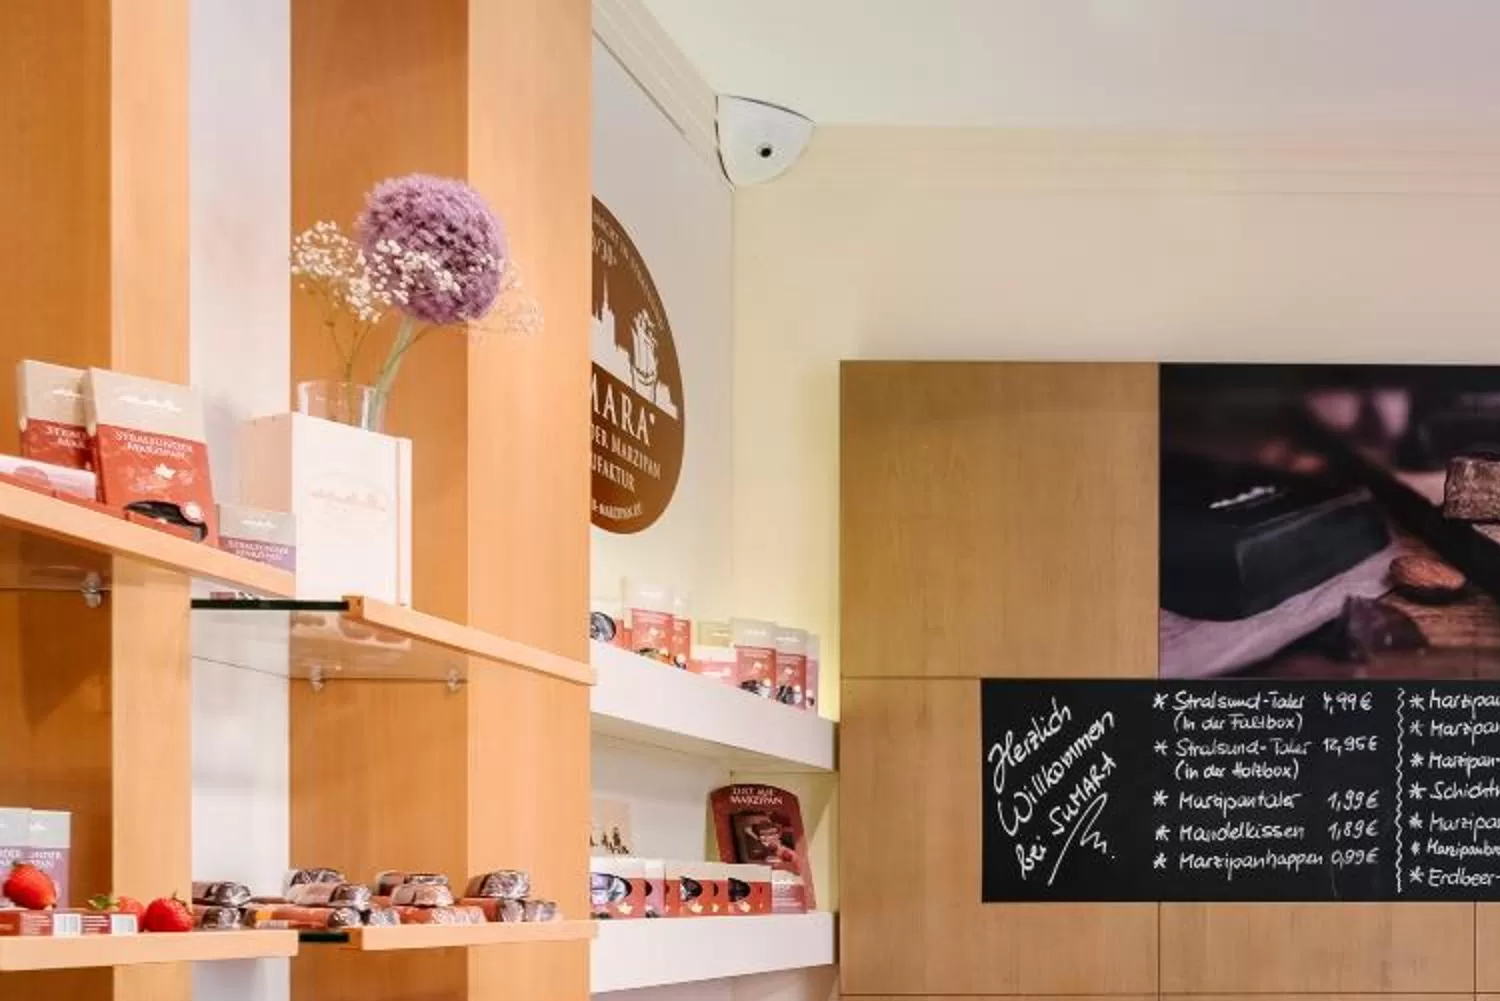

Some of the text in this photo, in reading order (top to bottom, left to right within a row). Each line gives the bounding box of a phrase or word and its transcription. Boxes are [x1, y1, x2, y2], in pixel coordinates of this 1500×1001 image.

[1201, 716, 1225, 730] der
[987, 695, 1072, 795] Herzlich
[997, 711, 1115, 837] Willkommen
[1203, 764, 1227, 779] der
[1327, 789, 1380, 811] 1,99€
[1179, 819, 1380, 842] Mandelkissen 1,89€
[1015, 834, 1048, 881] bei
[1179, 848, 1323, 881] Marzipanhappen
